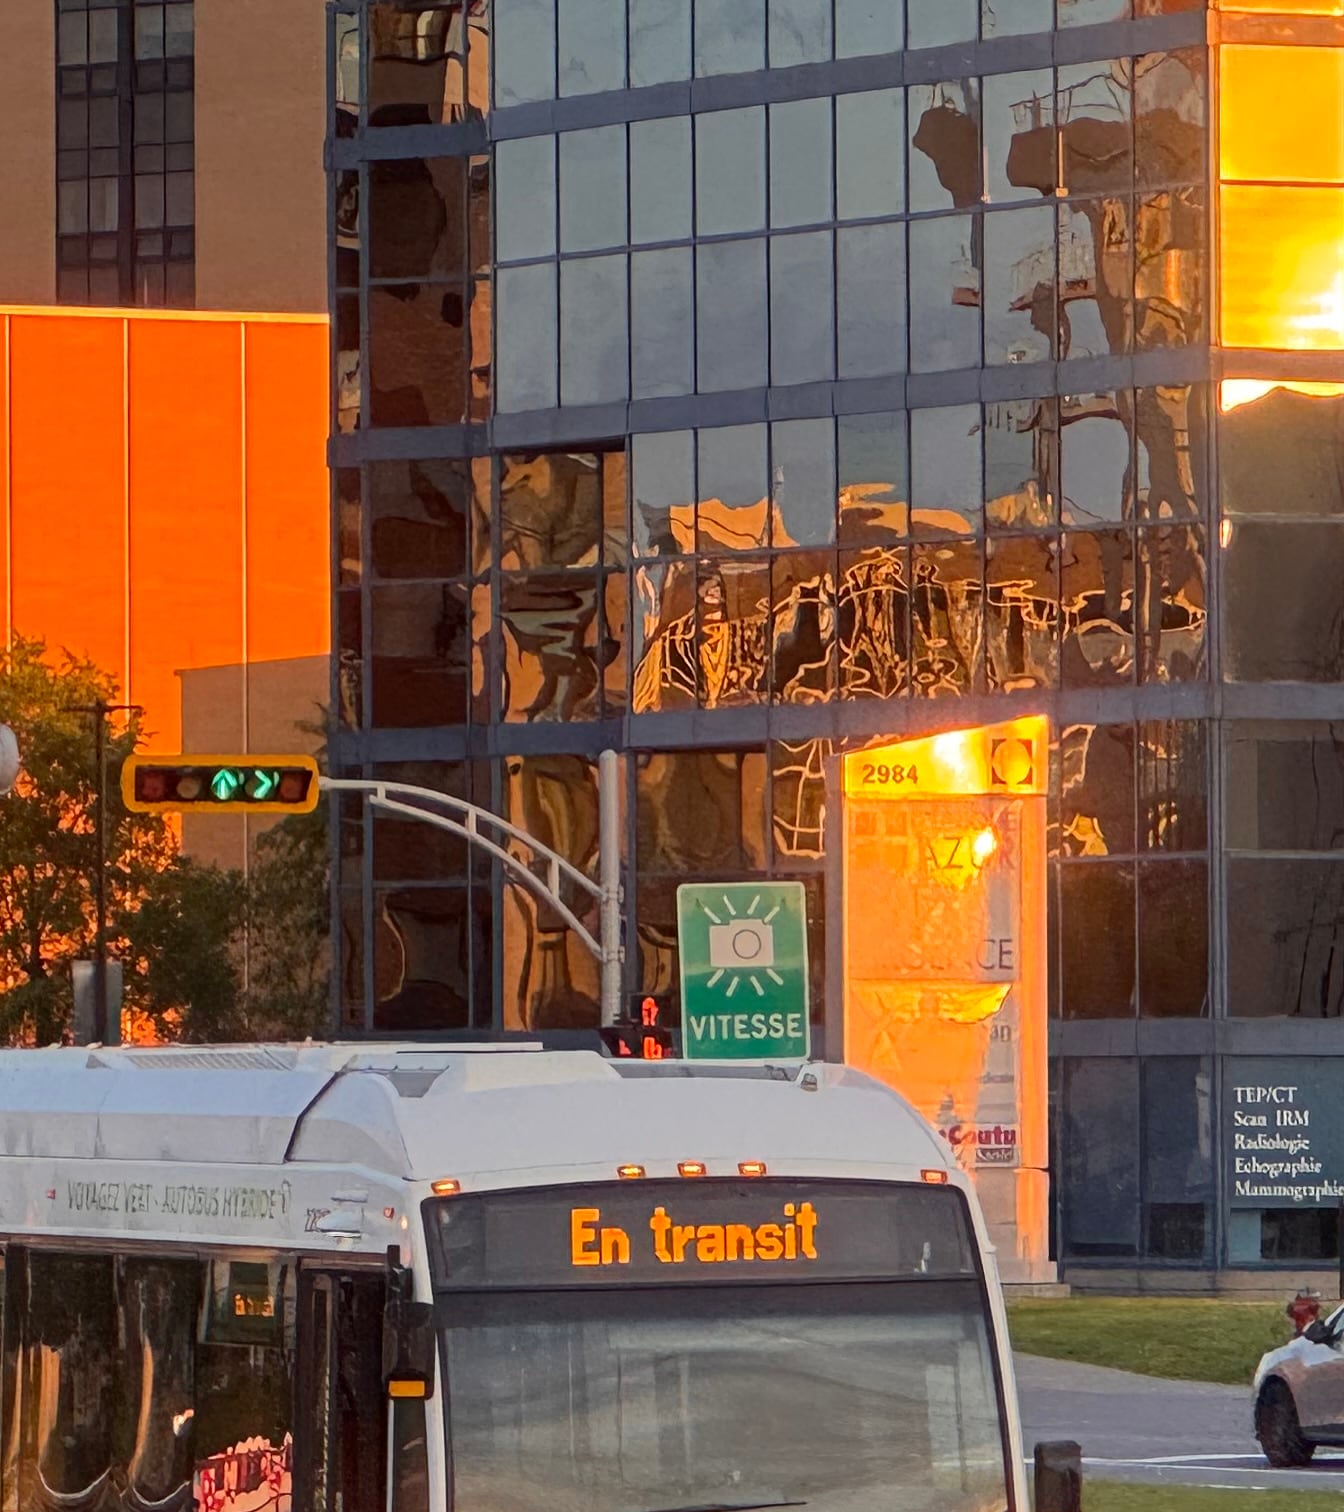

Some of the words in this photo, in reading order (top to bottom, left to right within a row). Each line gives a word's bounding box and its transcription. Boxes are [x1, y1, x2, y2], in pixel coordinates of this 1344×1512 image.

[862, 763, 919, 784] 2984
[690, 1013, 803, 1041] VITESSE
[1233, 1086, 1297, 1104] TEP/CT
[1234, 1110, 1267, 1127] Scan
[1276, 1109, 1309, 1127] IRM
[571, 1207, 630, 1266] En
[650, 1202, 818, 1263] transit
